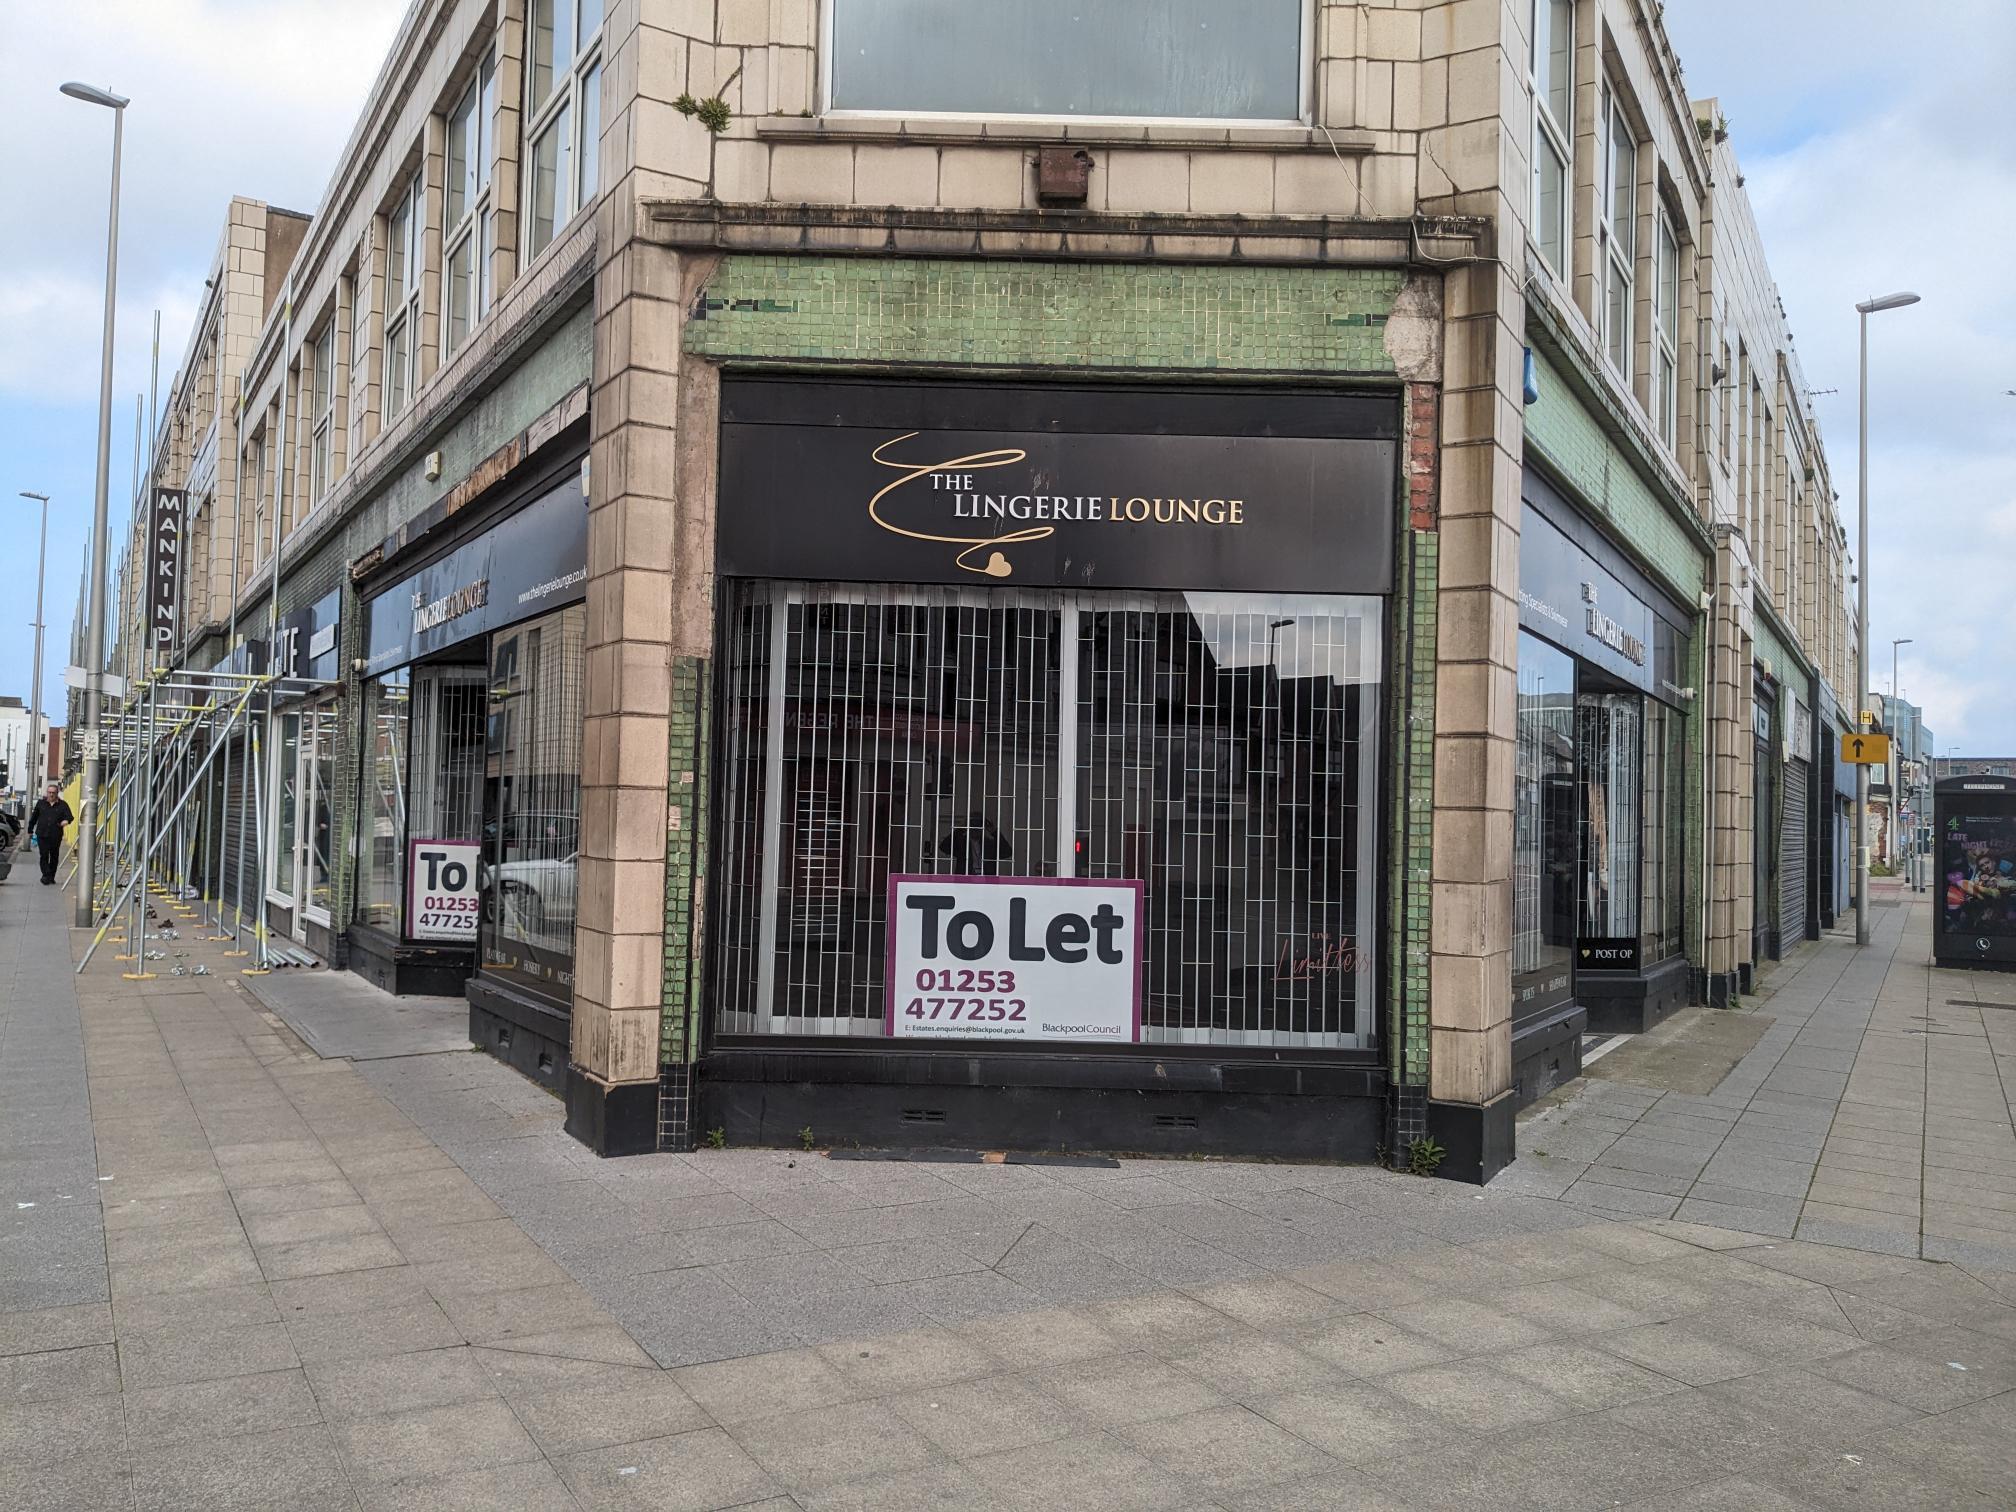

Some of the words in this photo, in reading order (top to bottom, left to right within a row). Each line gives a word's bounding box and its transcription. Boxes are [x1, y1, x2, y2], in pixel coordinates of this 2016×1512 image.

[929, 474, 974, 491] THE
[953, 494, 1102, 521] LINGERIE
[1108, 497, 1244, 524] LOUNGE
[157, 494, 181, 642] MANKIND
[420, 852, 468, 892] To
[424, 896, 481, 912] 01253
[905, 894, 995, 961] To
[1008, 896, 1124, 965] Let
[1595, 949, 1619, 959] POST
[1619, 949, 1633, 959] OP
[915, 968, 1016, 993] 01253
[905, 997, 1027, 1021] 477252
[912, 1025, 1025, 1035] Estates.enquiries@blackpool.gov.uk
